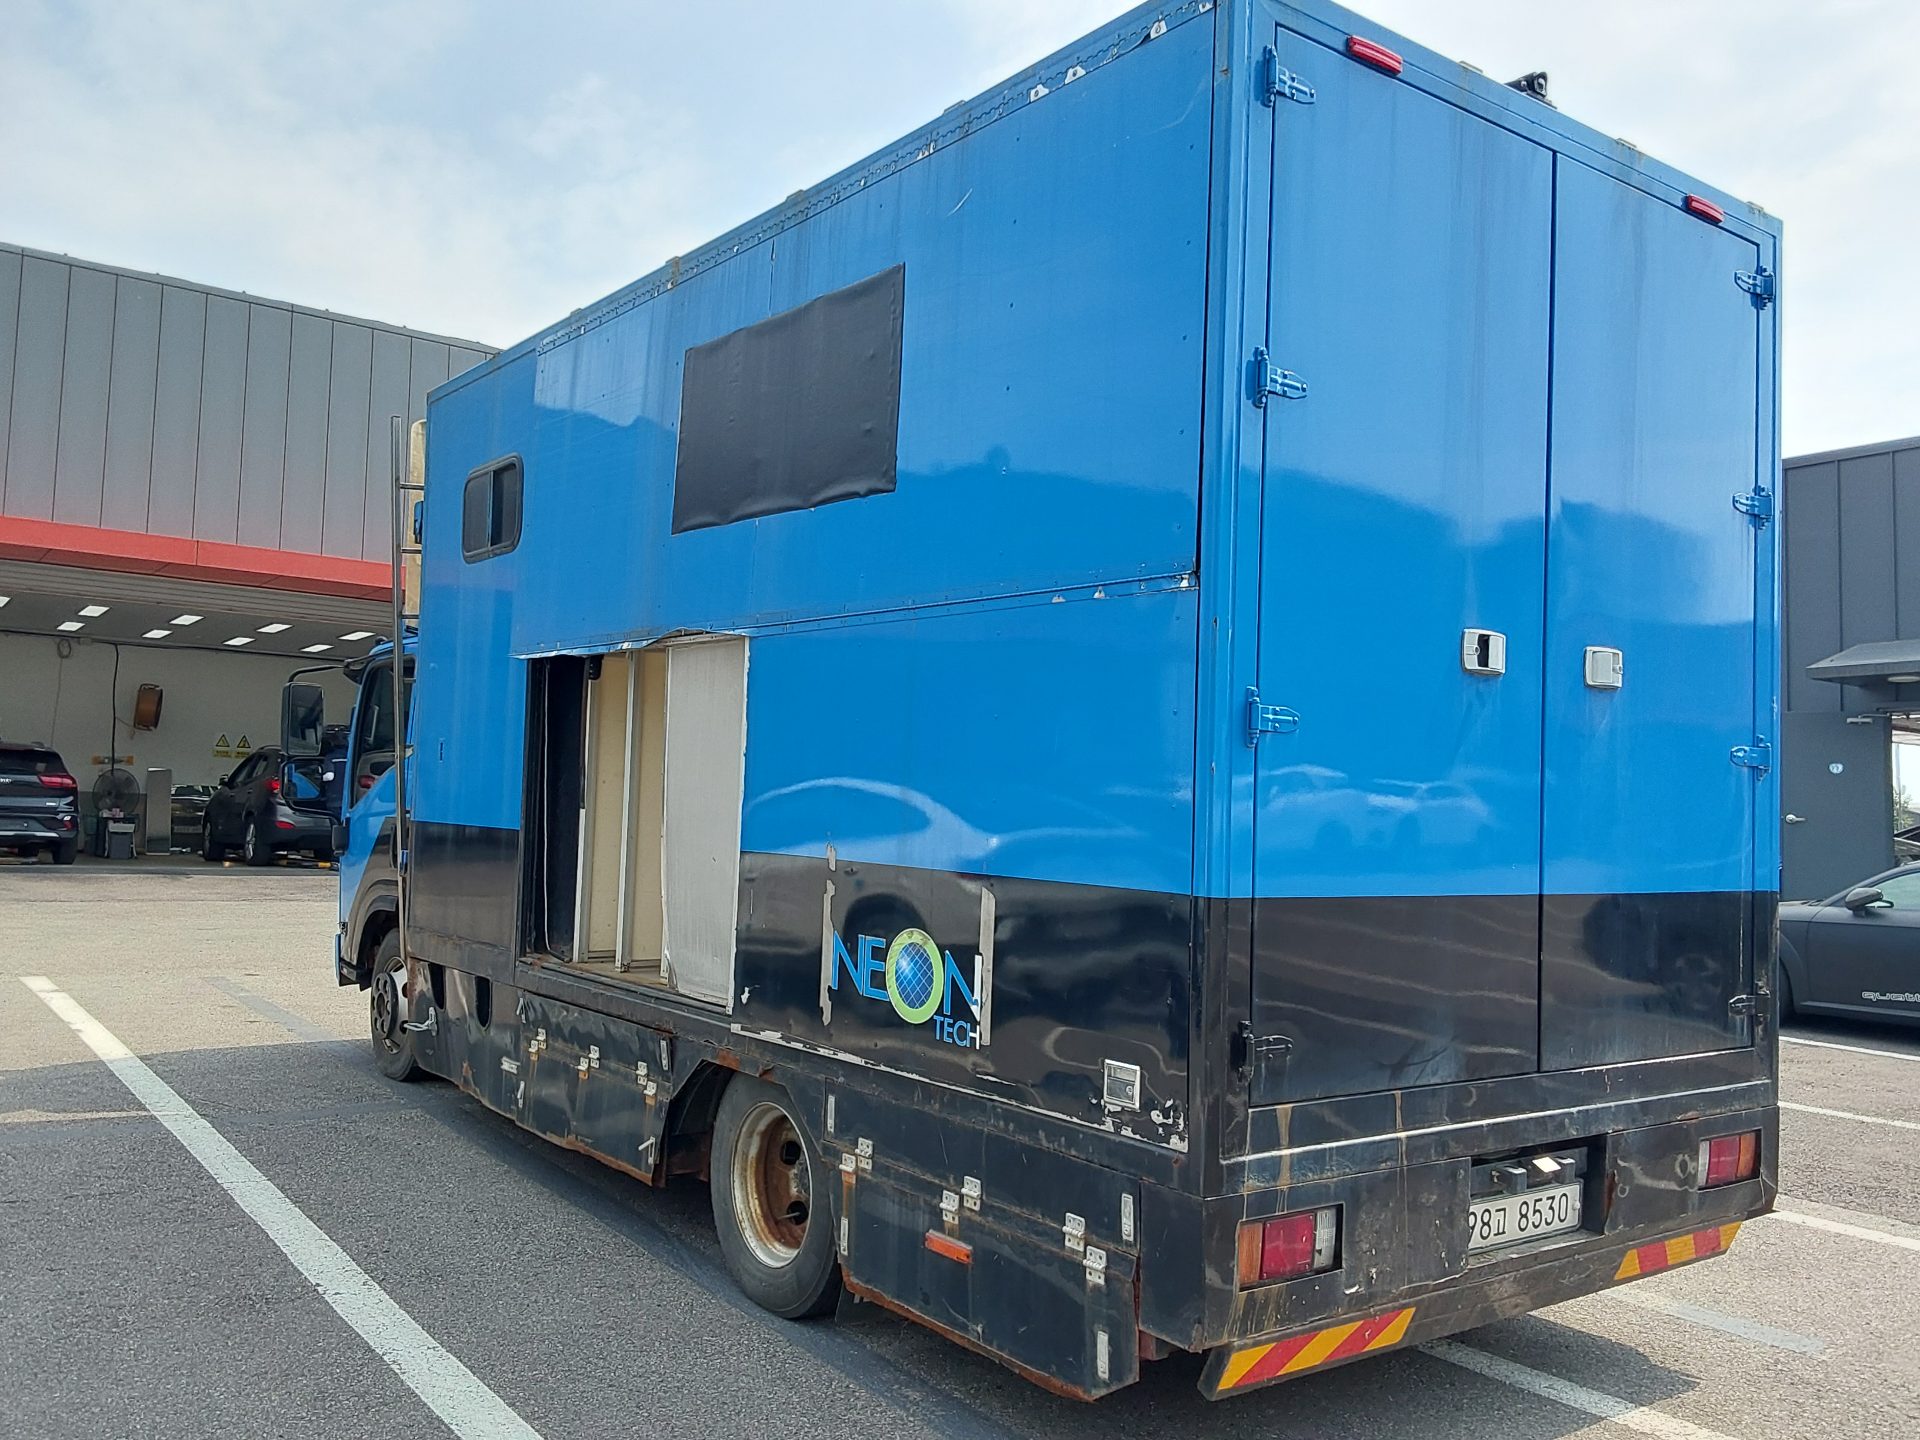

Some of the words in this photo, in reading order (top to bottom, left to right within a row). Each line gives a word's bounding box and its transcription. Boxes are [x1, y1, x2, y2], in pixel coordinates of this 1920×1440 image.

[831, 927, 983, 1025] NEON
[933, 1014, 980, 1050] TECH
[1517, 1192, 1569, 1233] 8530
